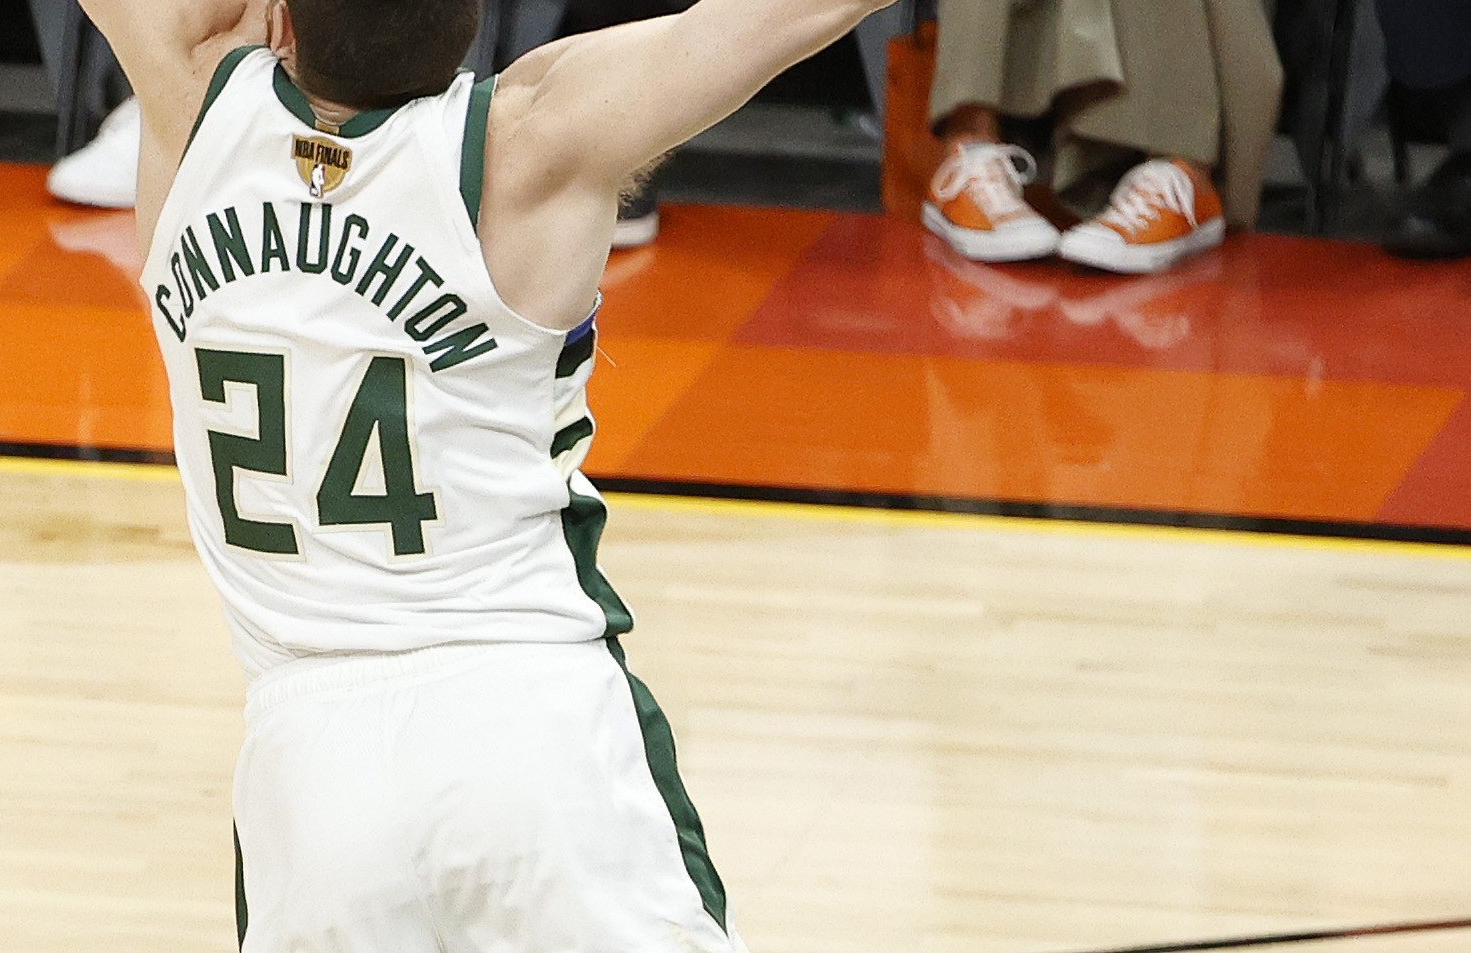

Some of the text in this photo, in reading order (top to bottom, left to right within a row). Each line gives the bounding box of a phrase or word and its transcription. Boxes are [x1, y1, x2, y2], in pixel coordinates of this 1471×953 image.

[295, 138, 350, 170] NBA FINALS
[155, 201, 499, 373] CONNAUGHTON
[192, 346, 442, 560] 24
